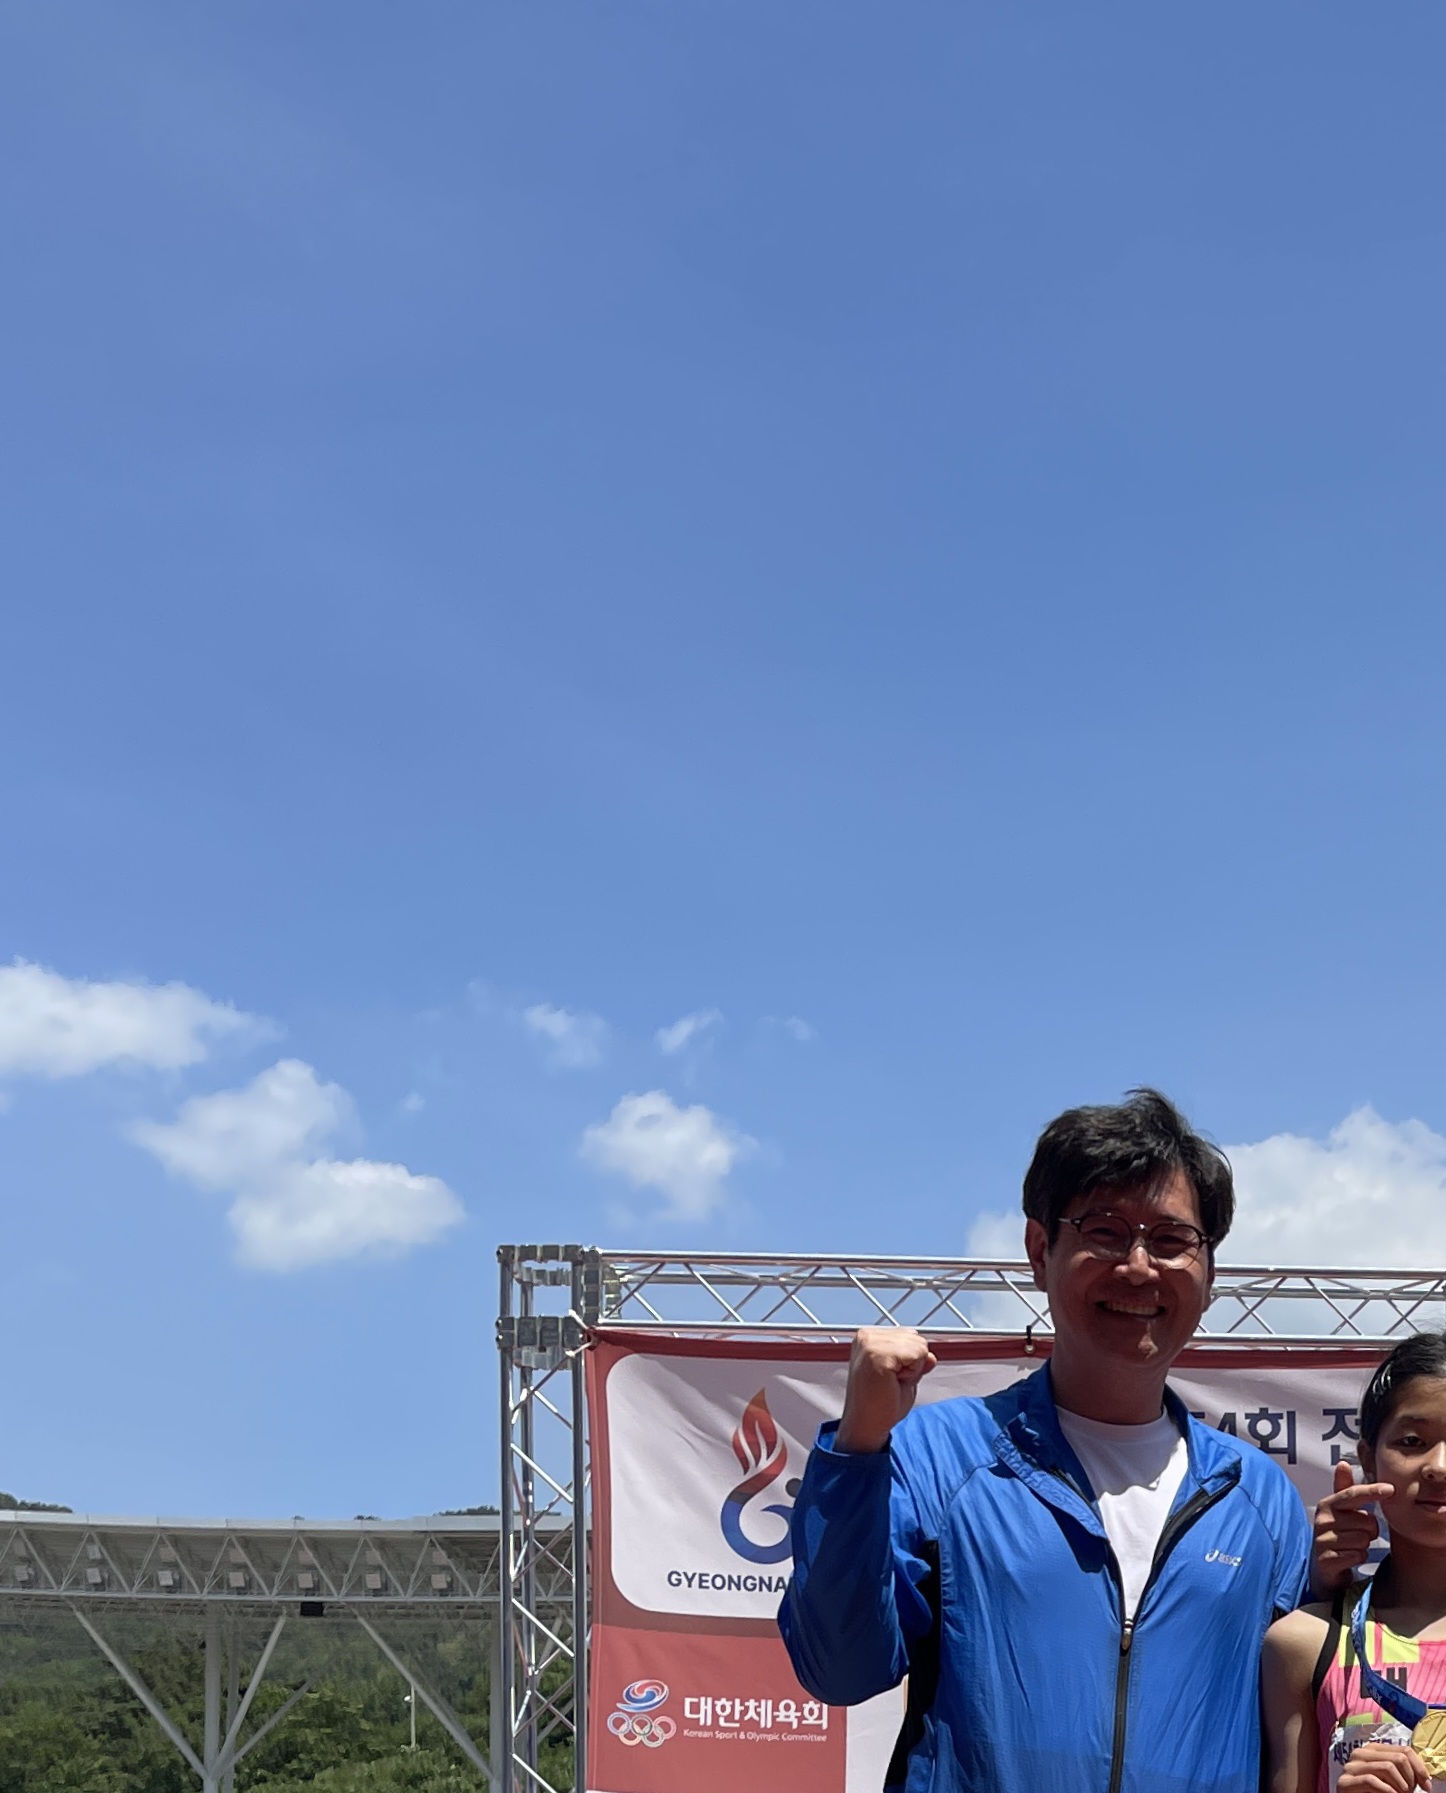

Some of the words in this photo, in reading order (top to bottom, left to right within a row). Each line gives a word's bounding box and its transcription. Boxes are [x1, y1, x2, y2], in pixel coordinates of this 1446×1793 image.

[667, 1570, 787, 1592] GYEONGNA
[684, 1697, 828, 1730] 대한체육회
[684, 1729, 713, 1737] Korean
[715, 1731, 737, 1739] Sport
[747, 1732, 779, 1742] Olympic
[782, 1733, 827, 1741] Committee
